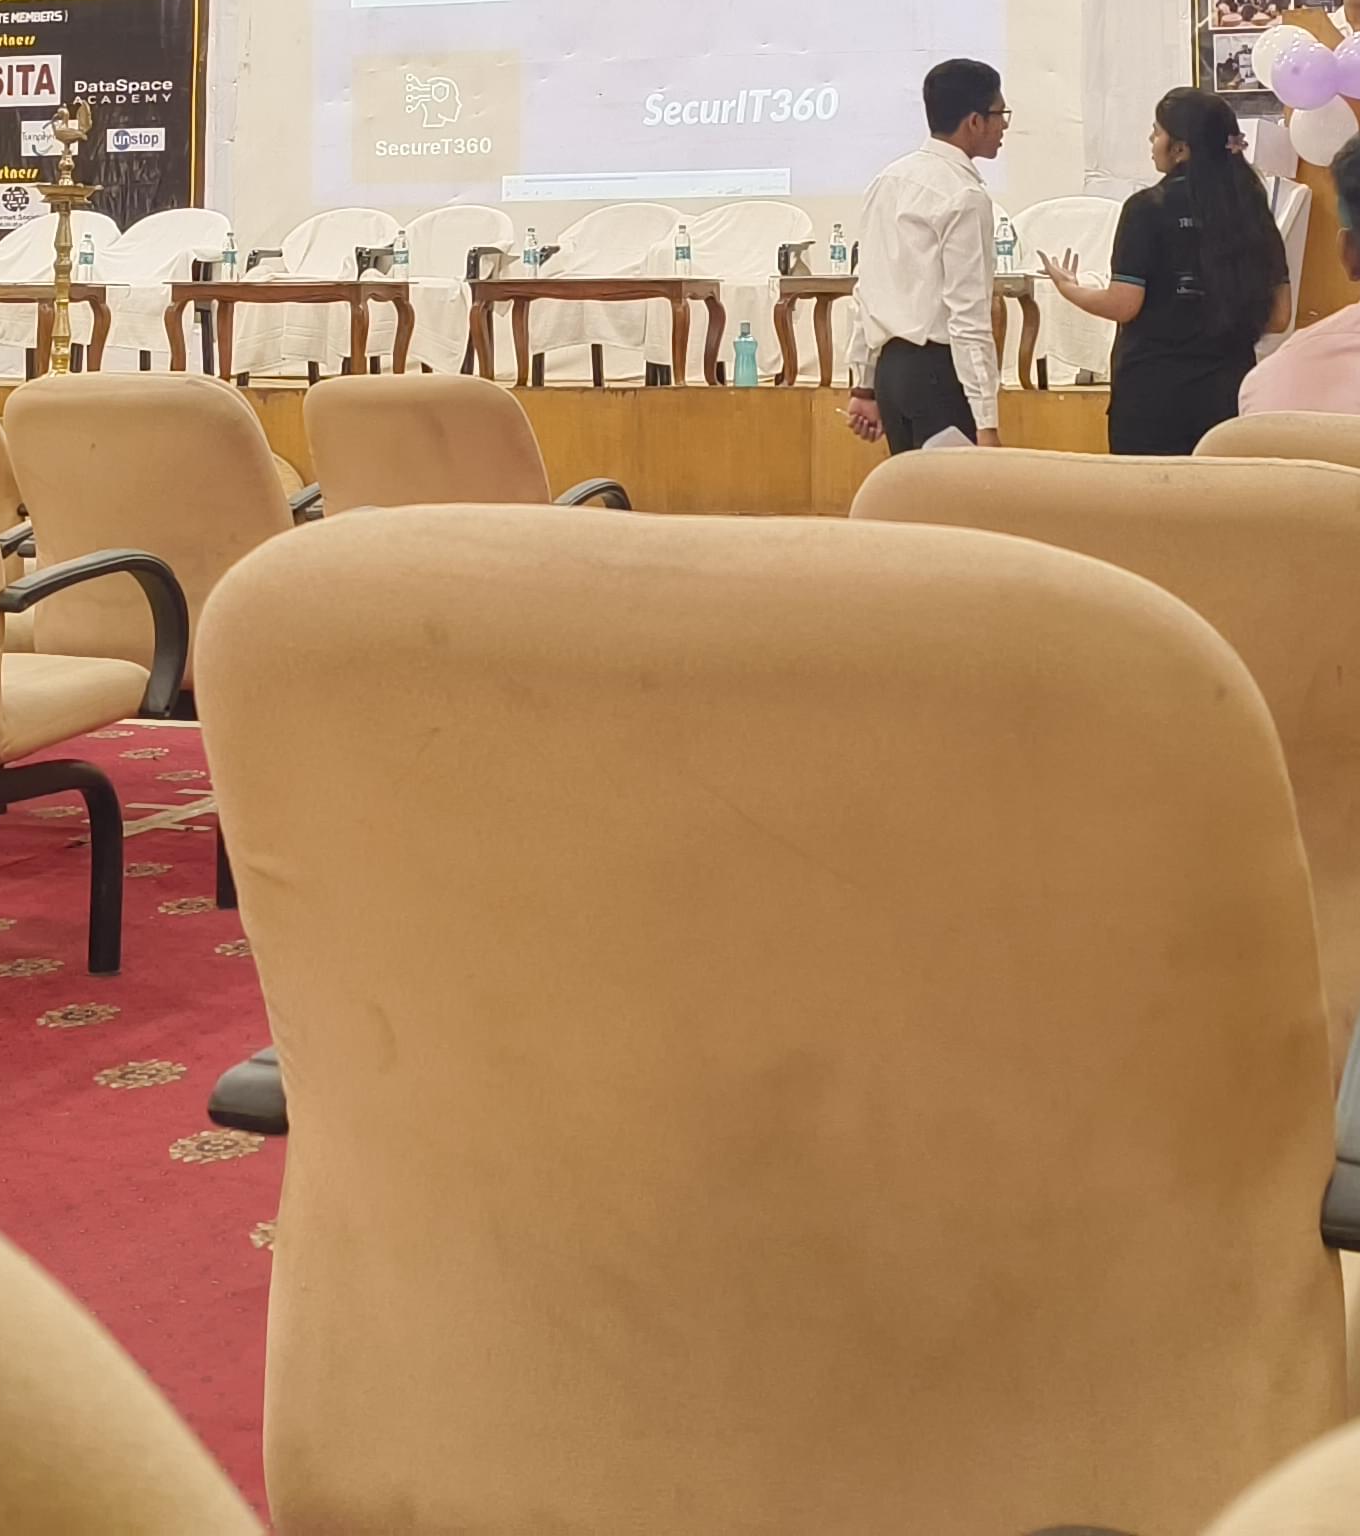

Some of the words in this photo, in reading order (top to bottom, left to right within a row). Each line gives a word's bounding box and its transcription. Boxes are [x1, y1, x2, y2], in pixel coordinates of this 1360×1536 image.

[74, 79, 174, 94] DataSpace
[73, 93, 172, 105] ACADEMY
[642, 85, 839, 127] SecurIT360
[114, 131, 160, 147] unstop
[374, 136, 492, 158] SecureT360
